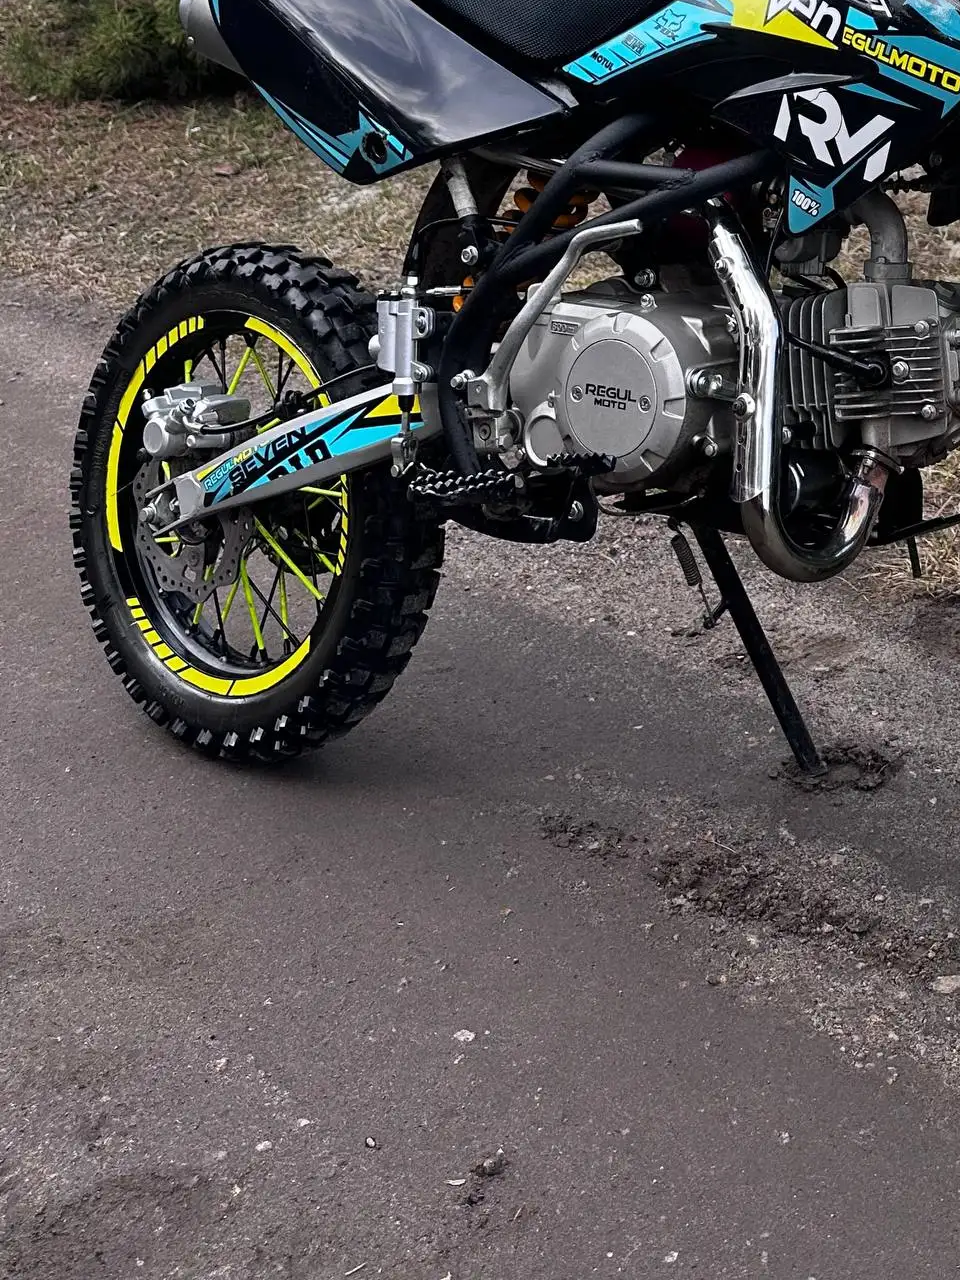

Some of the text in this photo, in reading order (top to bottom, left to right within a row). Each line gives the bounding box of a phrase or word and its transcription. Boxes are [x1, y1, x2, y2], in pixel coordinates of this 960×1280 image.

[590, 51, 615, 71] MOTUL
[791, 189, 822, 217] 100%
[585, 383, 637, 403] REGUL
[593, 397, 627, 411] MOTO
[228, 426, 307, 484] SEVEN
